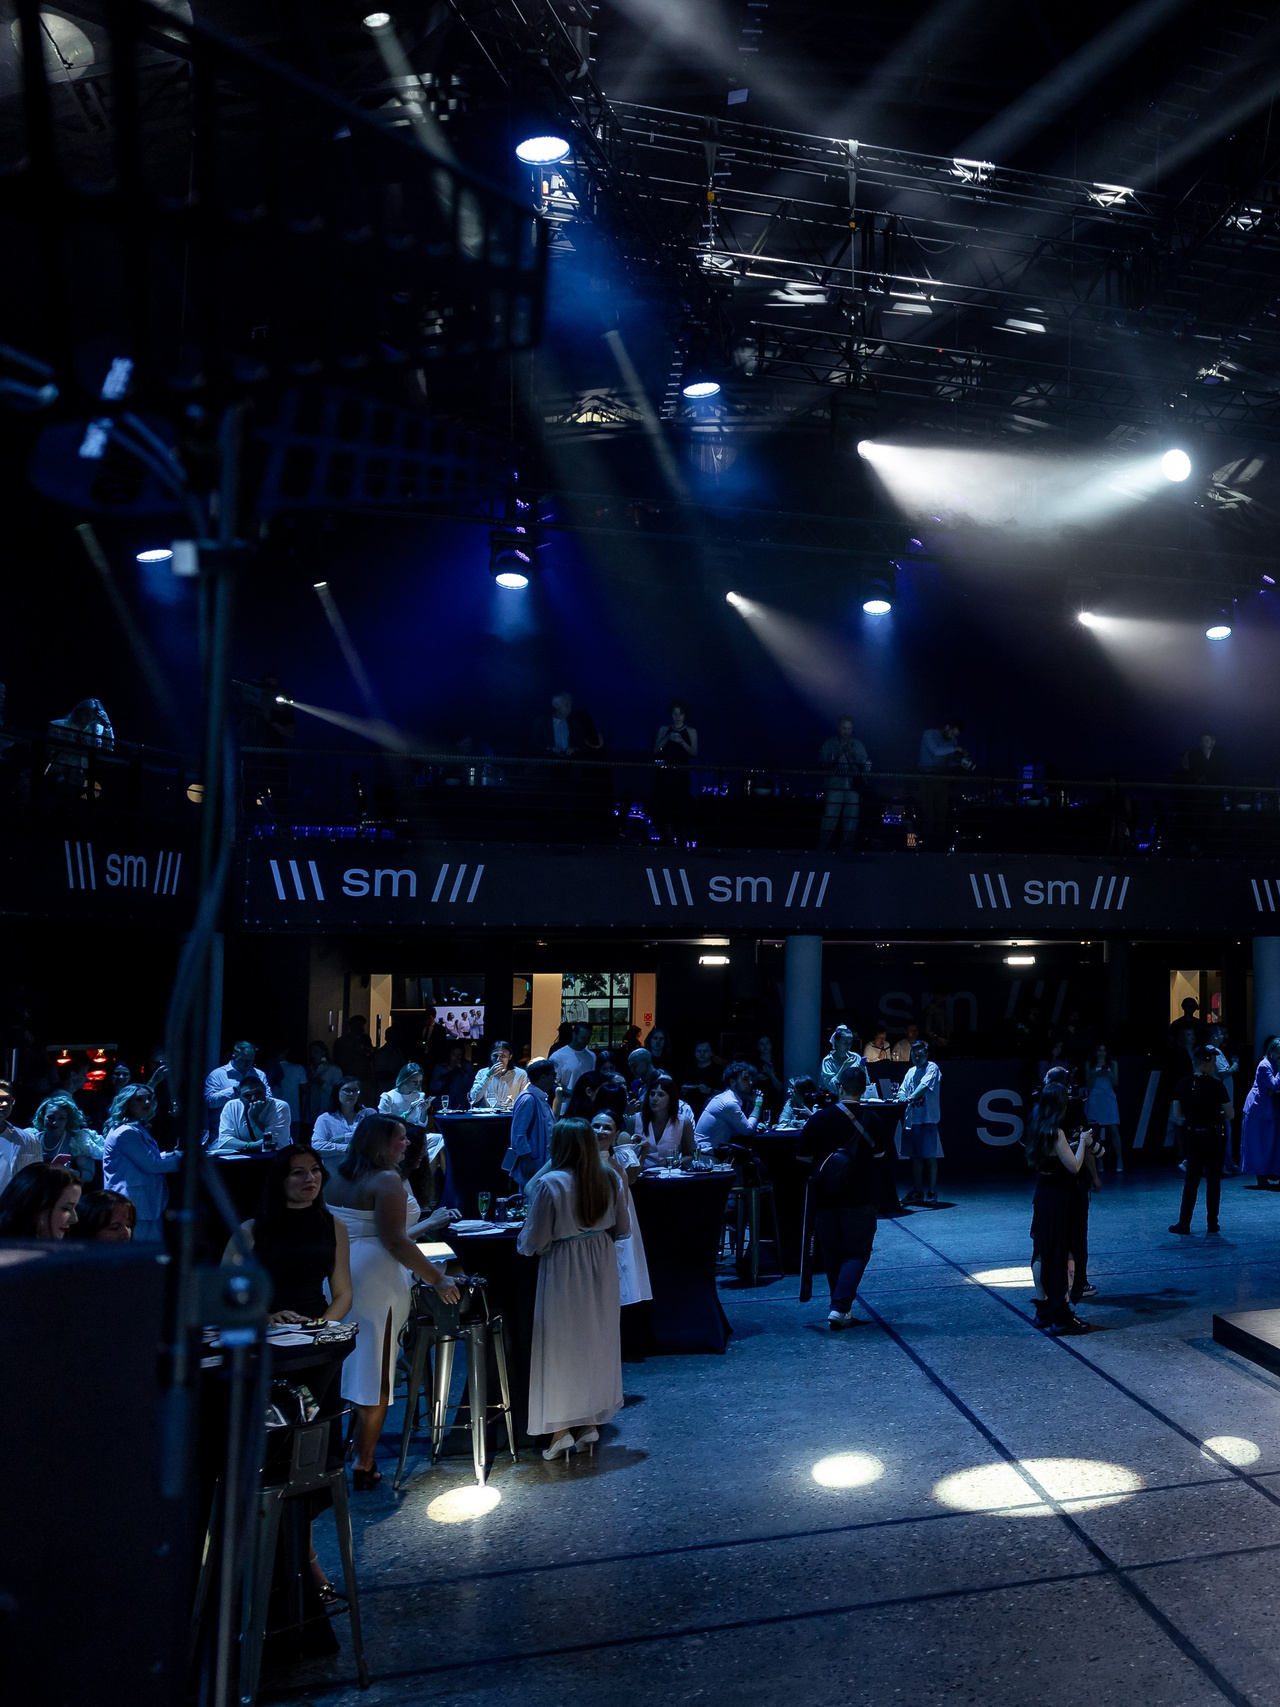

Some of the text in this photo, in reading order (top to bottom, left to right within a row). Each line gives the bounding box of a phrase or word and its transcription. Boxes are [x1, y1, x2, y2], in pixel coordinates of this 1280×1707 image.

[106, 853, 147, 888] sm
[342, 867, 417, 898] sm
[709, 875, 773, 903] sm
[1023, 879, 1079, 905] sm
